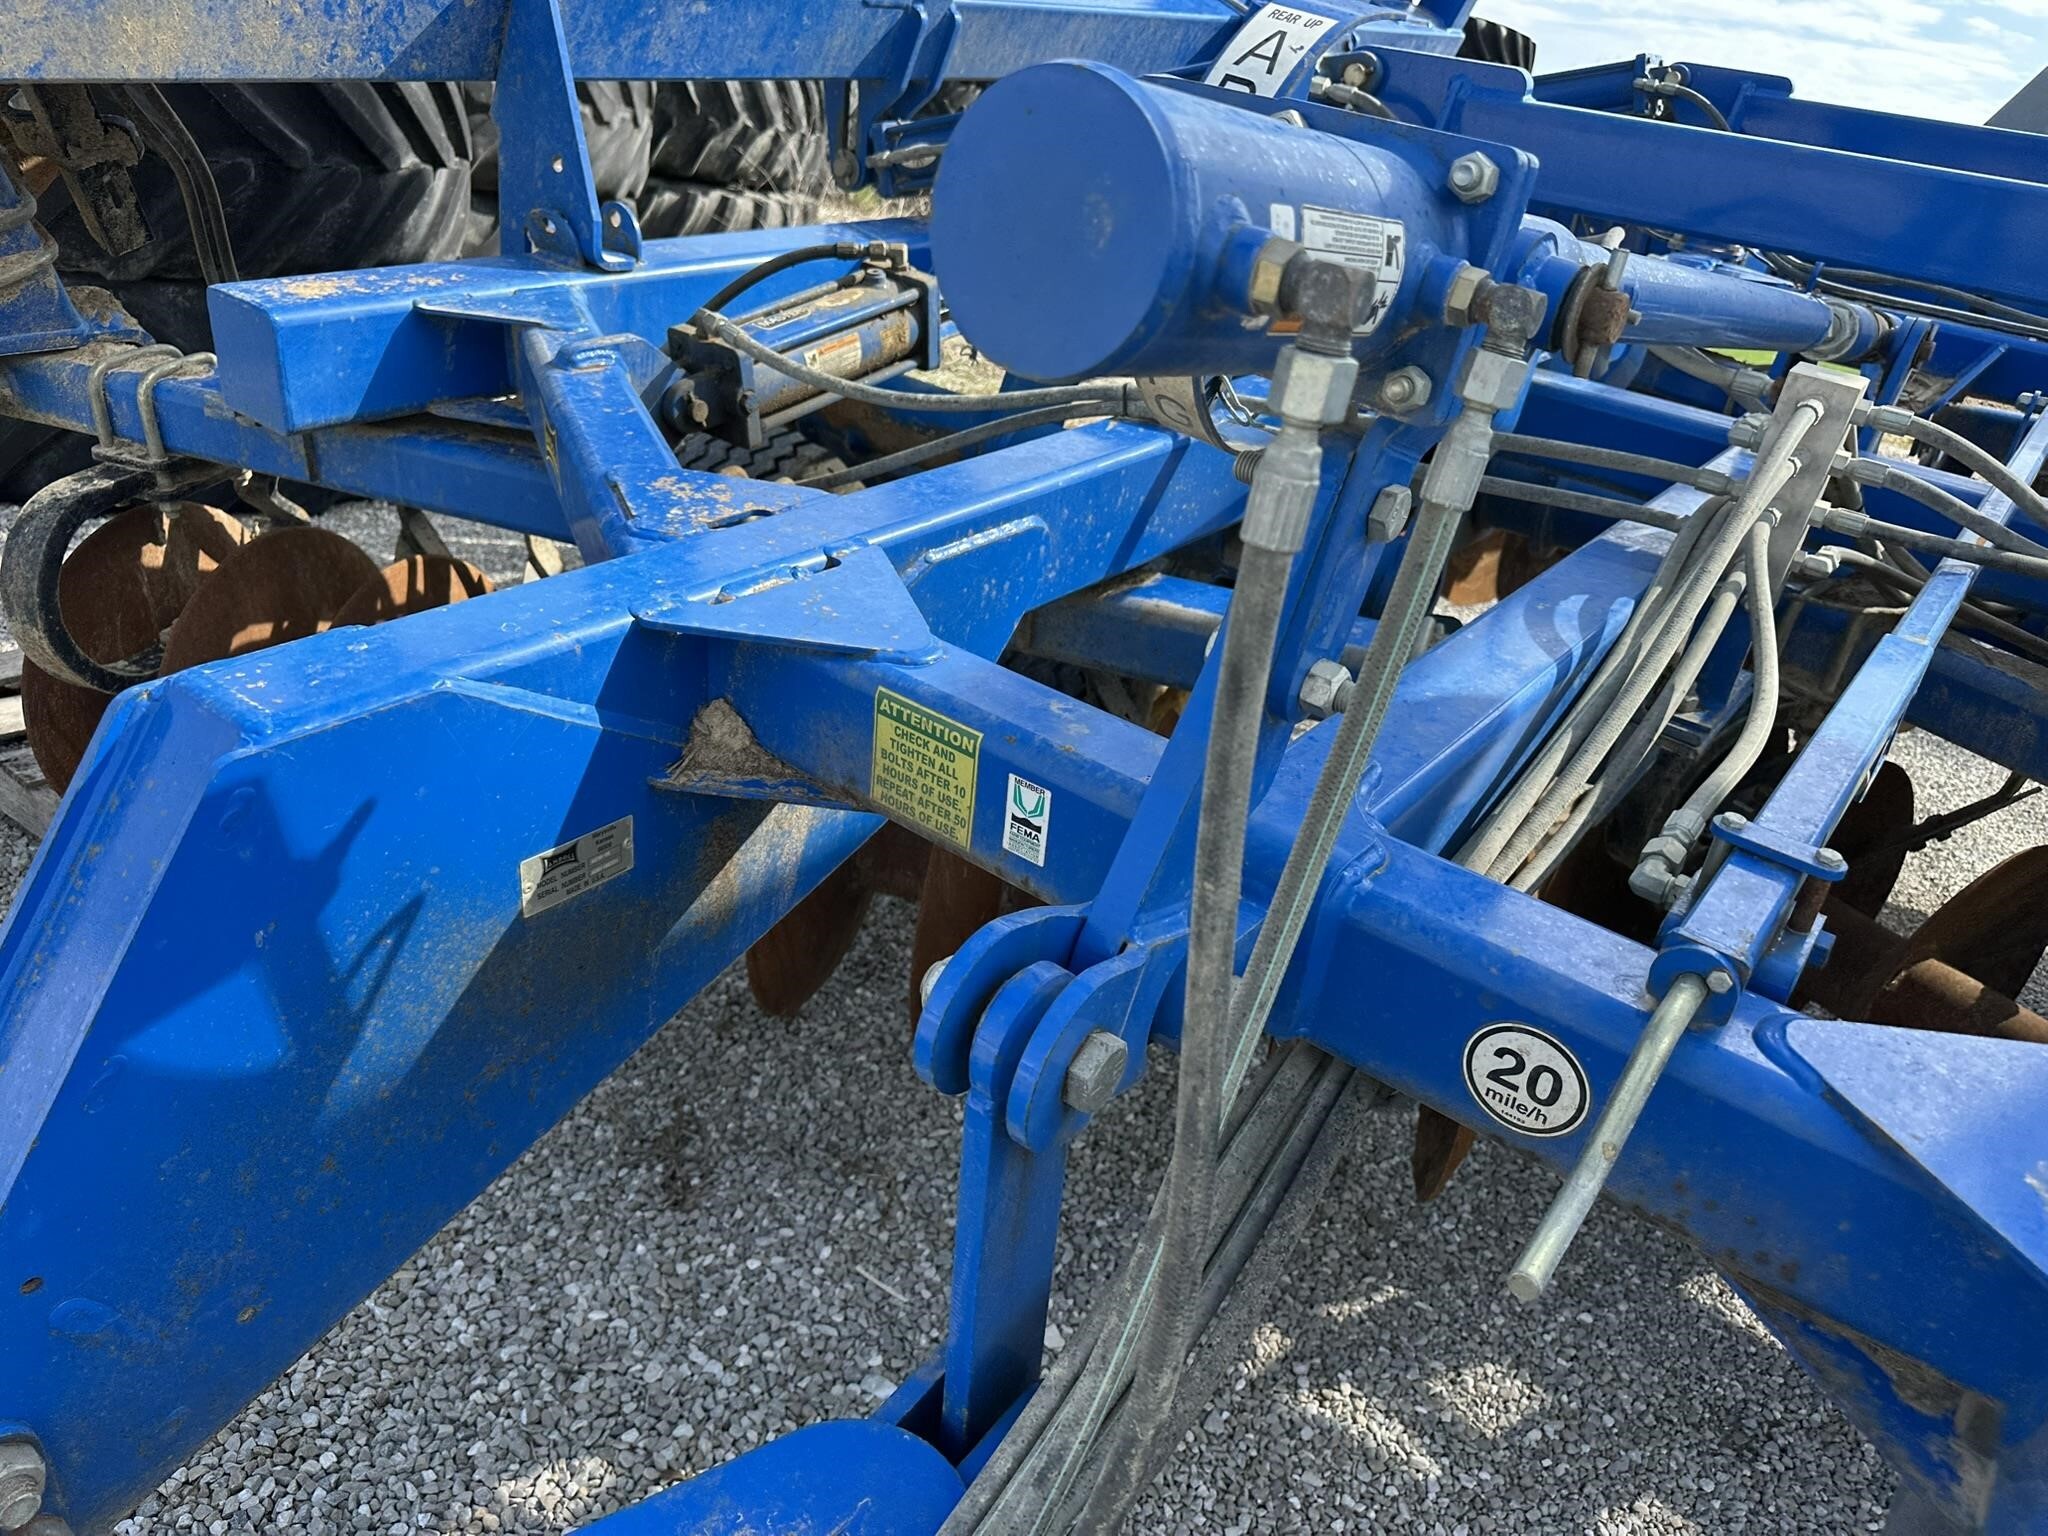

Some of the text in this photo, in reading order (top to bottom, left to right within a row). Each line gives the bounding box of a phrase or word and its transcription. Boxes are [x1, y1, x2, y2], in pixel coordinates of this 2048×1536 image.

[1267, 8, 1324, 30] REAR UP
[1232, 29, 1288, 76] A
[1154, 393, 1194, 428] G
[879, 698, 975, 754] ATTENTION
[894, 725, 957, 764] CHECK AND
[880, 747, 967, 799] BOLTS AFTER 10
[889, 737, 959, 781] TIGHTEN ALL
[876, 775, 967, 830] REPEAT AFTER 50
[882, 764, 962, 813] HOURS OF USE.
[1014, 776, 1046, 797] MEMBER
[880, 790, 960, 841] HOURS OF USE.
[1010, 822, 1041, 843] FEMA
[536, 876, 558, 890] MODEL
[560, 862, 587, 879] NUMBER
[536, 872, 587, 900] SERIAL NUMBER
[1485, 1046, 1563, 1108] 20
[1484, 1086, 1549, 1127] mile/h
